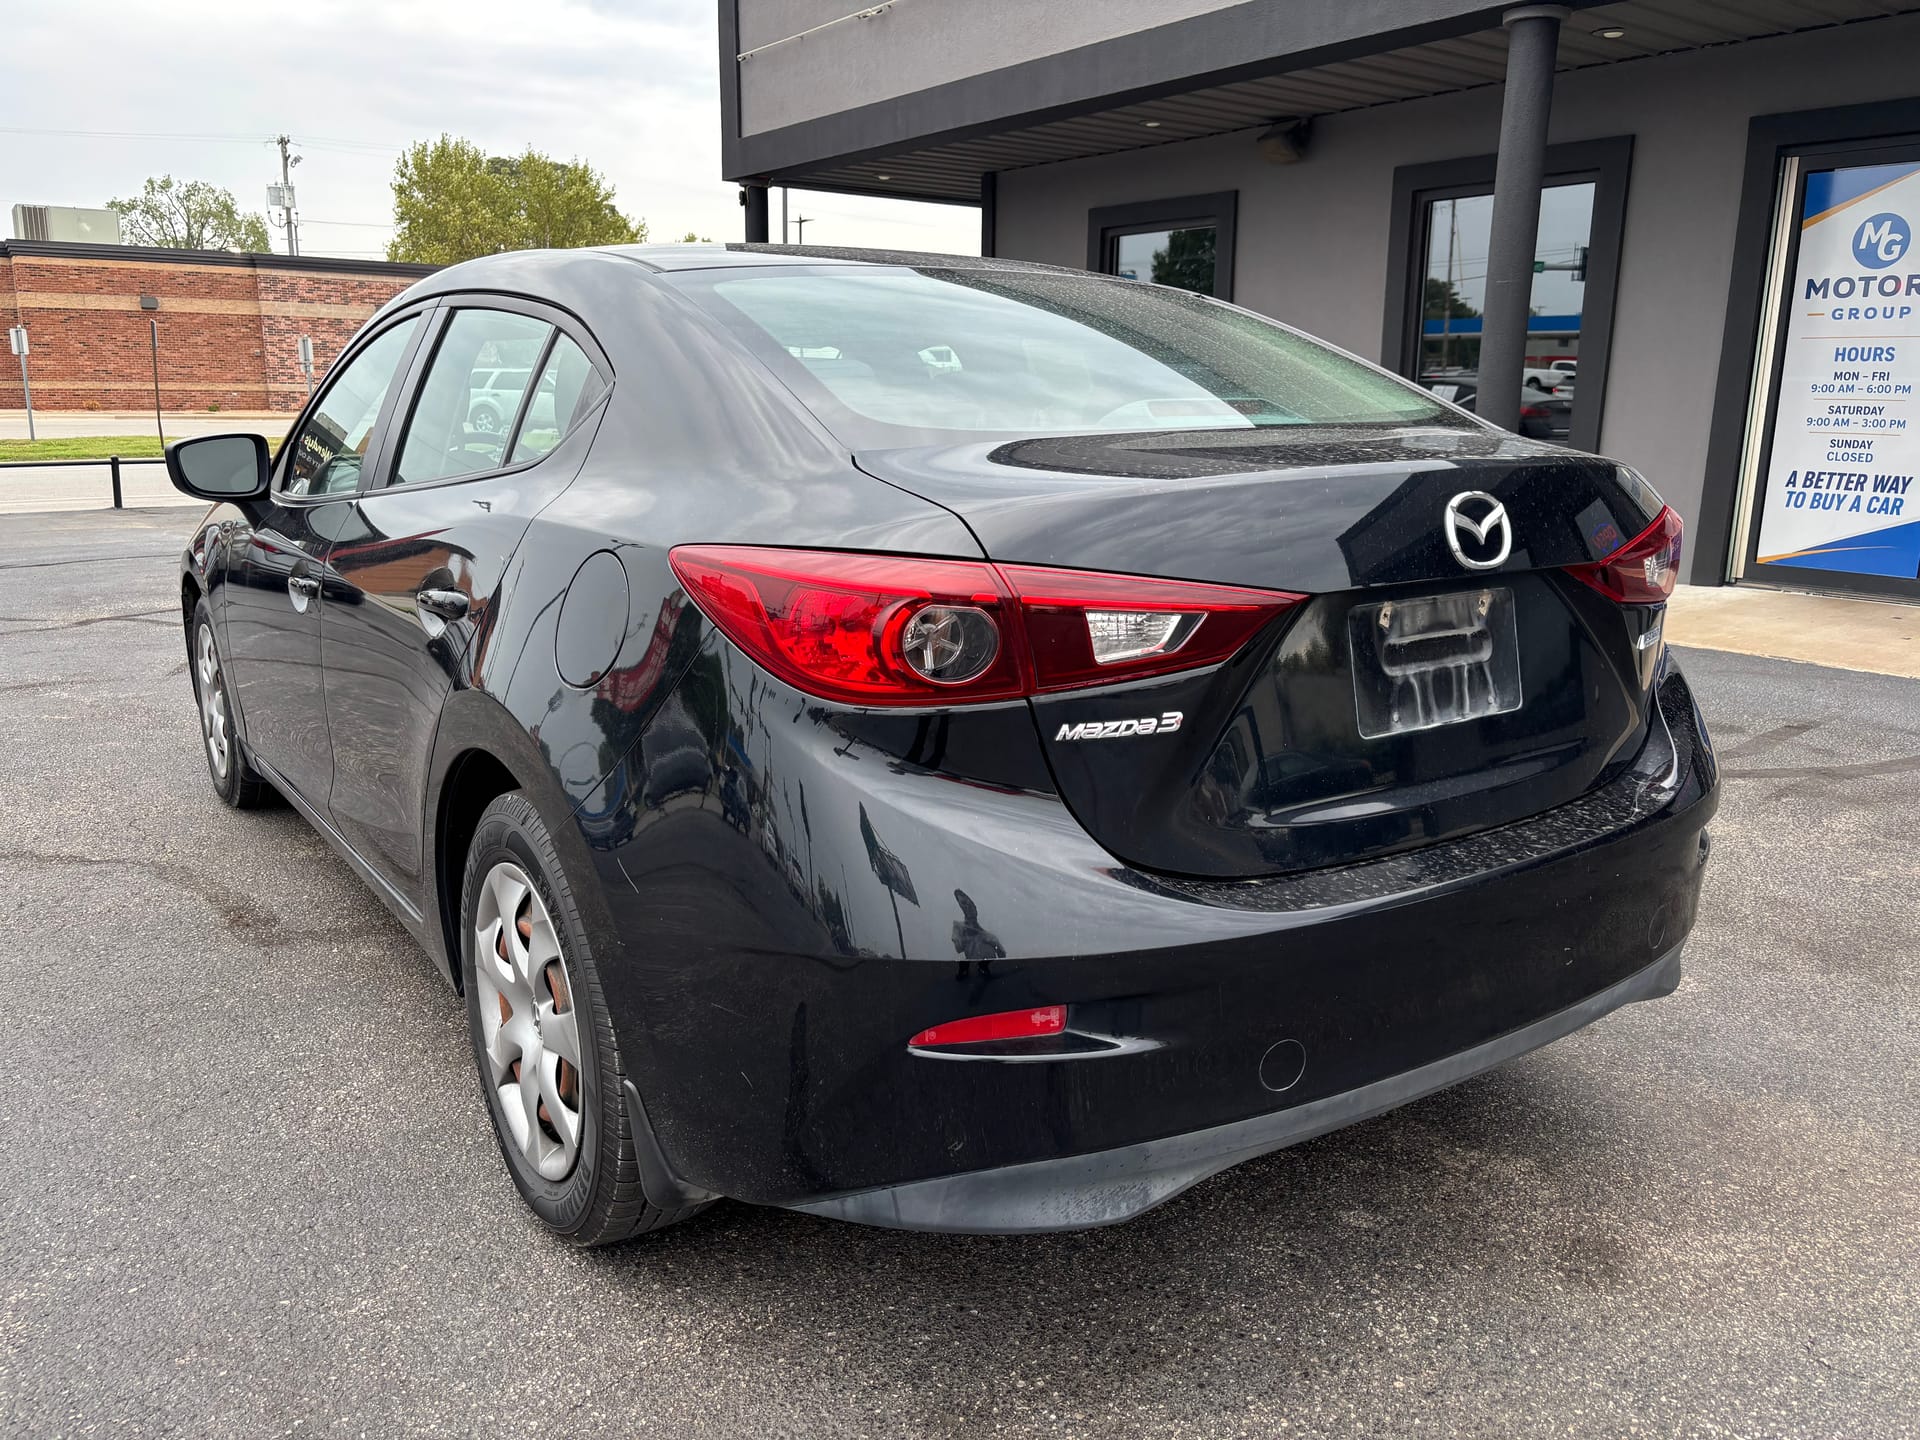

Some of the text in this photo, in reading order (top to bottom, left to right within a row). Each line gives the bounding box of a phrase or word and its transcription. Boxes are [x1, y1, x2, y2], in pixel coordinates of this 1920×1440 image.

[1859, 220, 1903, 261] MG
[1805, 275, 1920, 299] MOTOR
[1831, 306, 1912, 321] GROUP
[1834, 347, 1896, 362] HOURS
[1833, 371, 1860, 381] MON
[1871, 372, 1890, 382] FRI
[1811, 384, 1835, 393] 9:00
[1838, 384, 1855, 393] AM
[1866, 385, 1892, 394] 6:00
[1894, 385, 1912, 394] PM
[1827, 405, 1885, 416] SATURDAY
[1806, 417, 1830, 426] 9:00
[1833, 418, 1850, 427] AM
[1861, 419, 1887, 428] 3:00
[1889, 419, 1907, 429] PM
[1829, 438, 1873, 450] SUNDAY
[1826, 451, 1874, 463] CLOSED
[1785, 470, 1914, 495] A BETTER WAY
[1785, 490, 1905, 516] TO BUY A CAR
